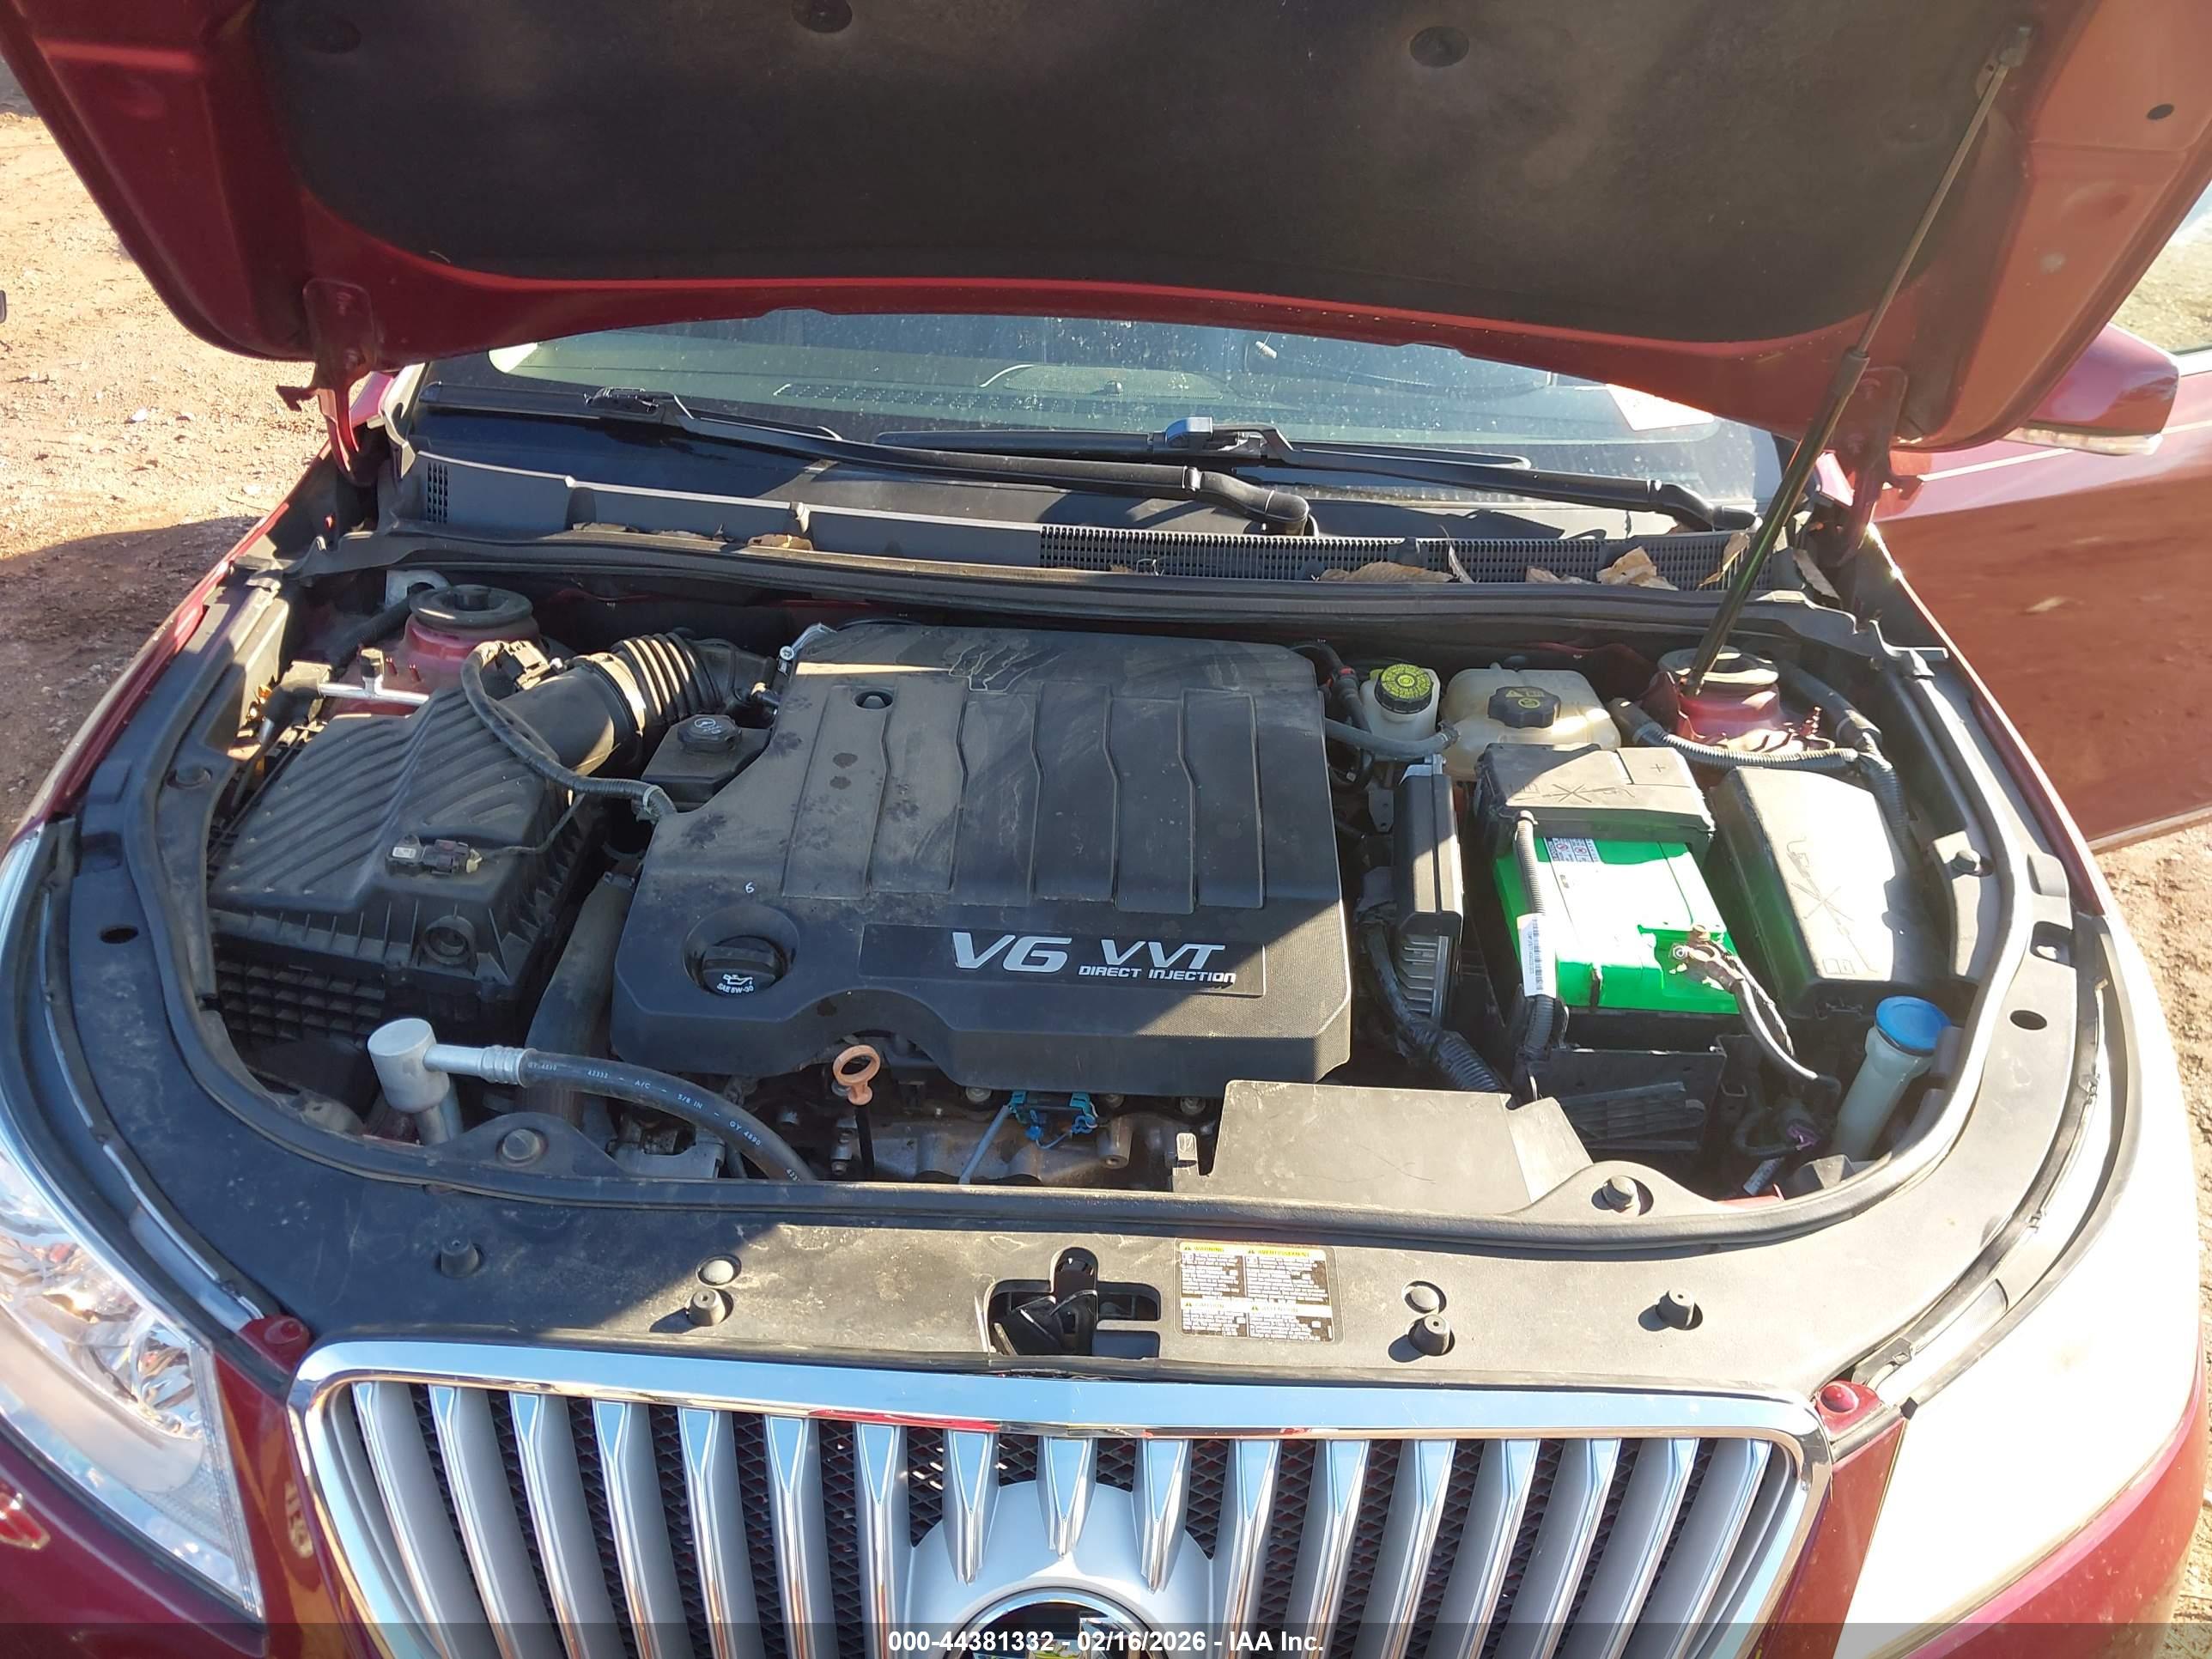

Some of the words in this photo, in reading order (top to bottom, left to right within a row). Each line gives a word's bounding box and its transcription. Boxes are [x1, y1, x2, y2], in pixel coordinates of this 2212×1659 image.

[951, 933, 1072, 973] V6
[1100, 939, 1225, 970] VVT
[1079, 965, 1141, 979] DIRECT
[1148, 969, 1237, 984] INJECTION
[635, 1079, 652, 1091] A/C
[693, 1101, 703, 1109] IN
